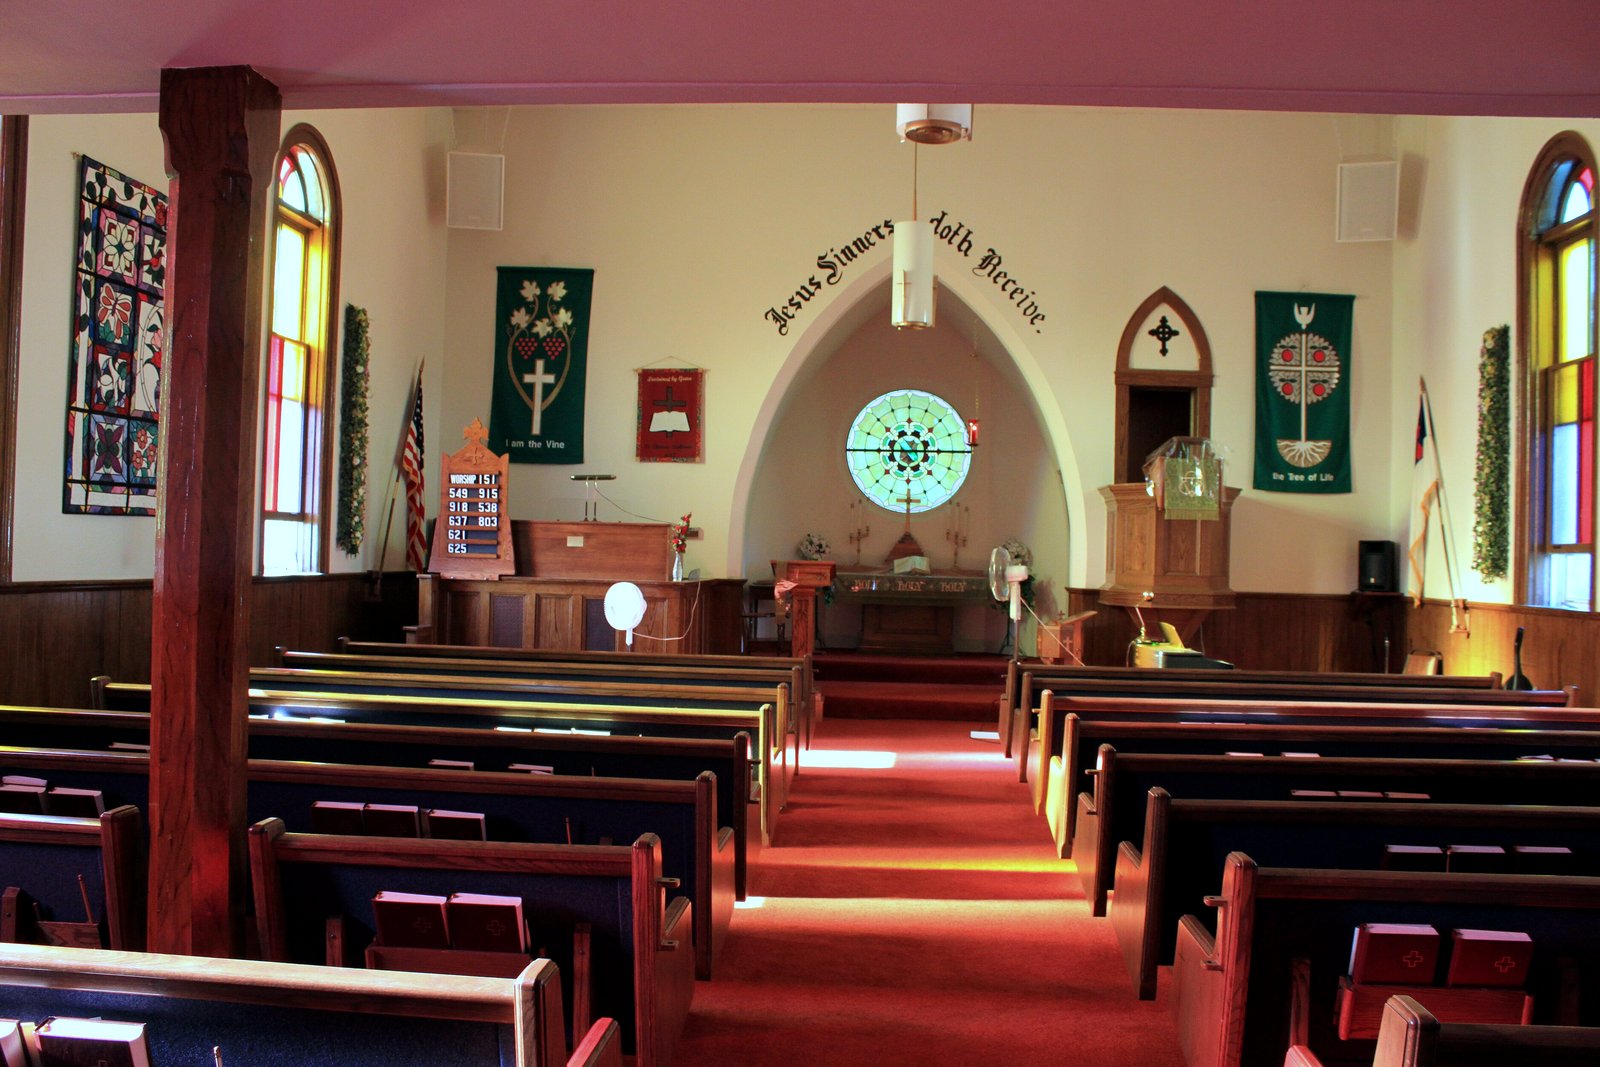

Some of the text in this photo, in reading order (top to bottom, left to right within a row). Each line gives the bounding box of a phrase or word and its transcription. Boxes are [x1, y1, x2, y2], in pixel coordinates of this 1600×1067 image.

[764, 210, 1046, 336] Jesus Sinners doth Receive.
[511, 440, 524, 448] am
[528, 440, 542, 448] the
[546, 440, 565, 449] Vine
[450, 474, 495, 484] WORSHIP 151
[1287, 472, 1305, 482] Tree
[1307, 473, 1317, 482] of
[449, 488, 498, 498] 549 915
[449, 502, 498, 512] 918 538
[448, 516, 498, 526] 637 803
[448, 530, 466, 540] 621
[448, 544, 467, 554] 625
